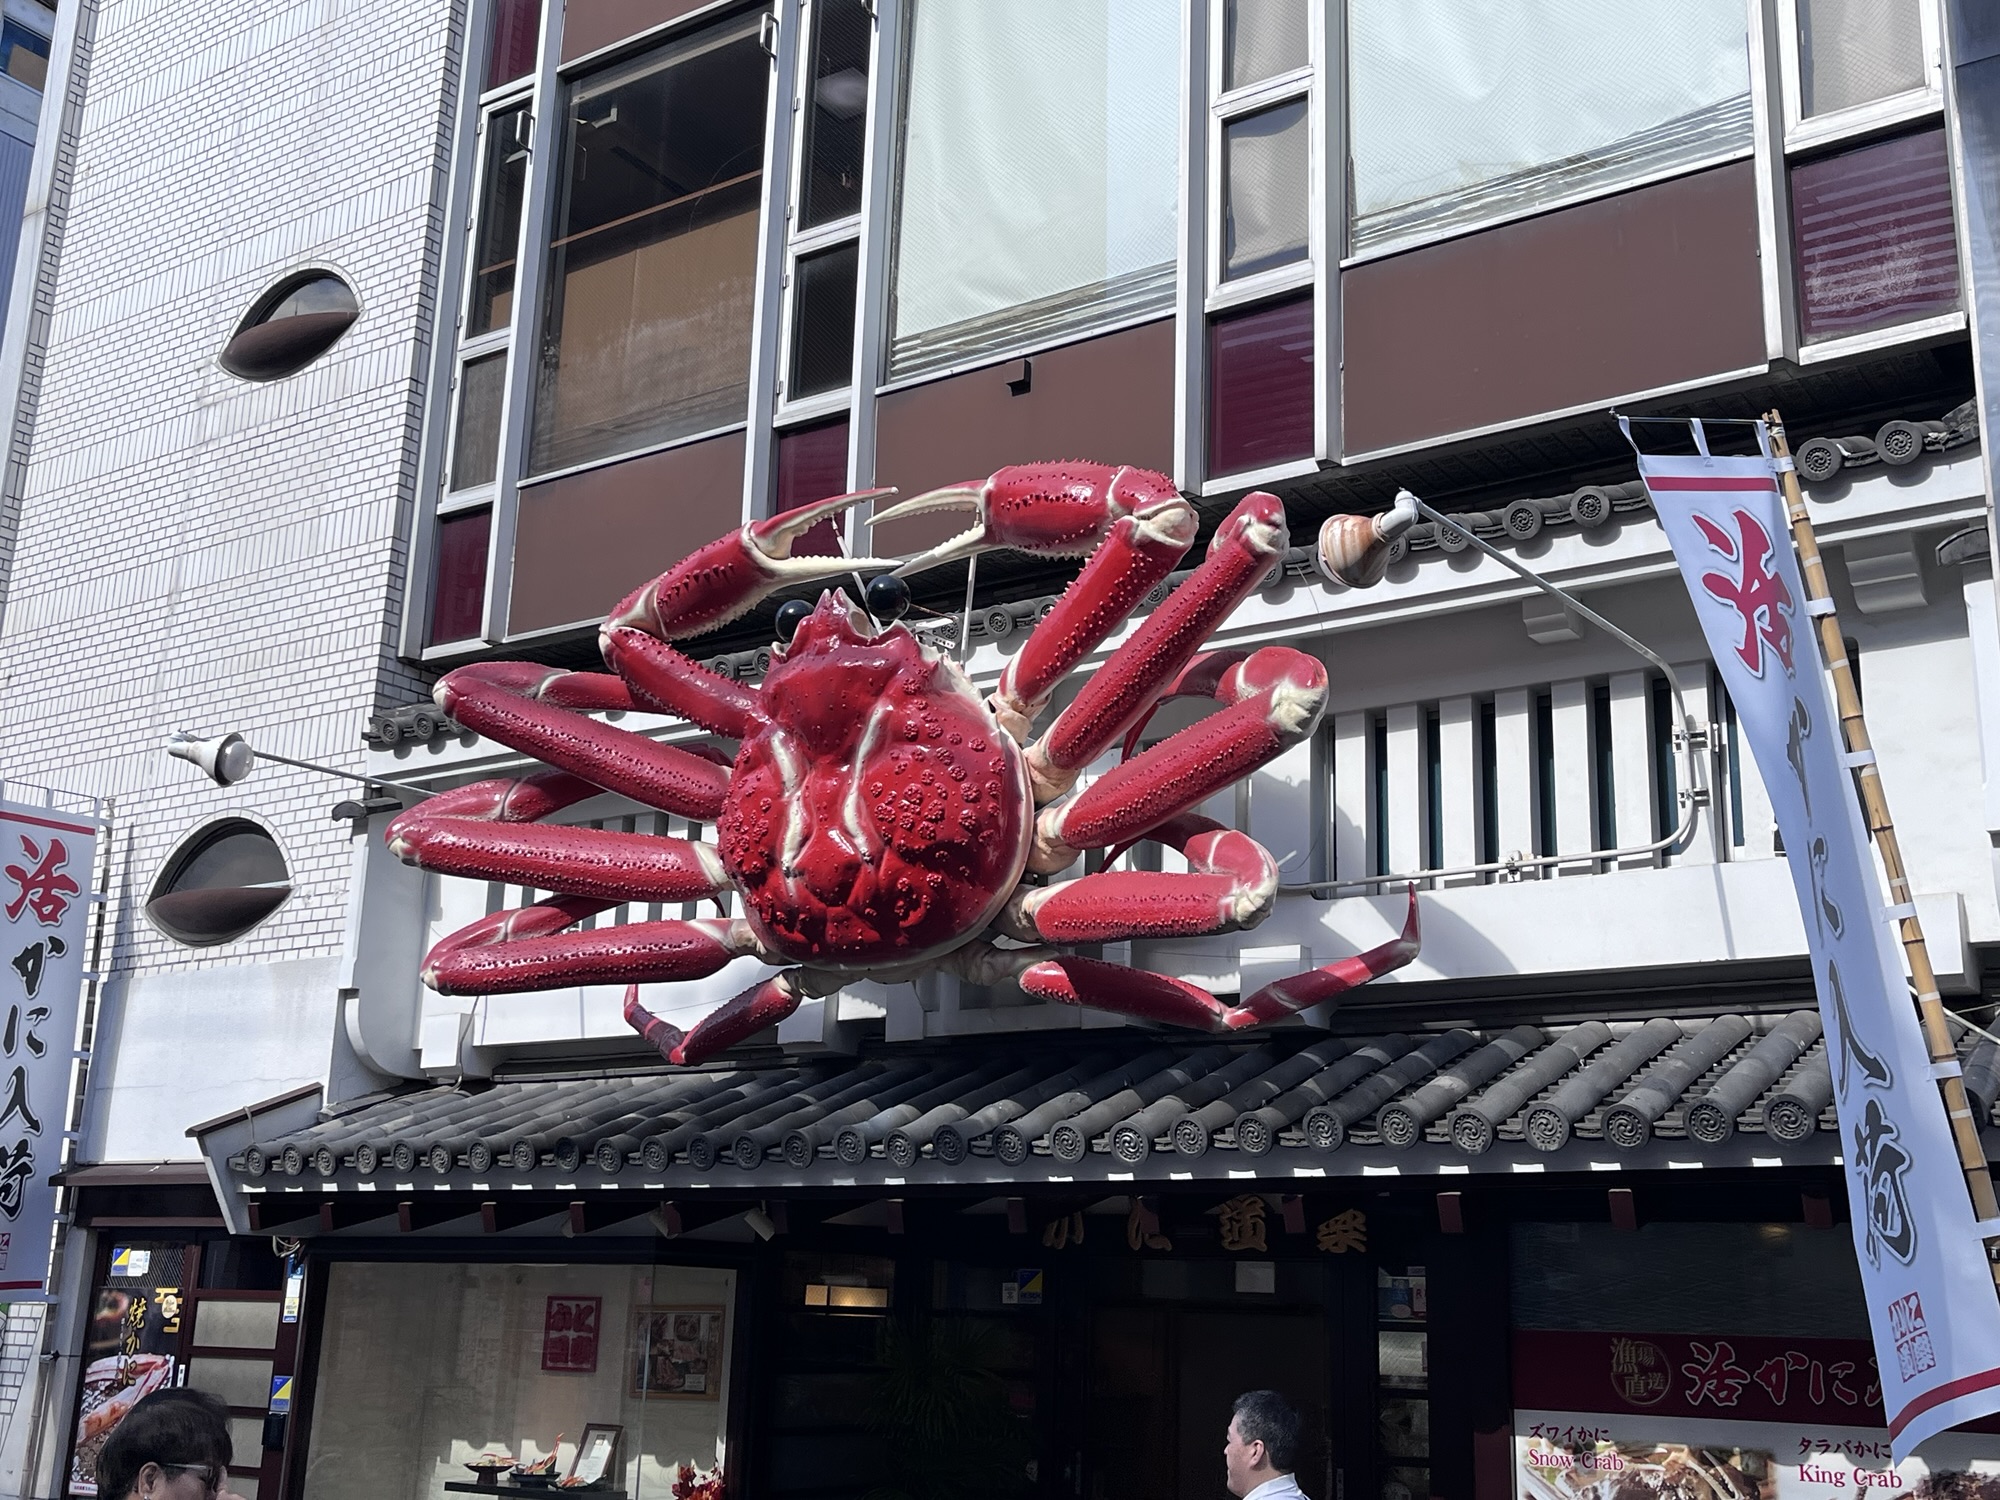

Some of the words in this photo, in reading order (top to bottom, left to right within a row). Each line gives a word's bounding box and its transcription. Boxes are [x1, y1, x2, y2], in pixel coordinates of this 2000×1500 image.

[1681, 1340, 1884, 1407] 活かに
[1528, 1422, 1611, 1443] ズワイかに
[1528, 1448, 1575, 1468] Snow
[1581, 1452, 1624, 1471] Crab
[1797, 1437, 1892, 1459] タラバかに
[1797, 1463, 1846, 1488] King
[1853, 1467, 1903, 1489] Crab
